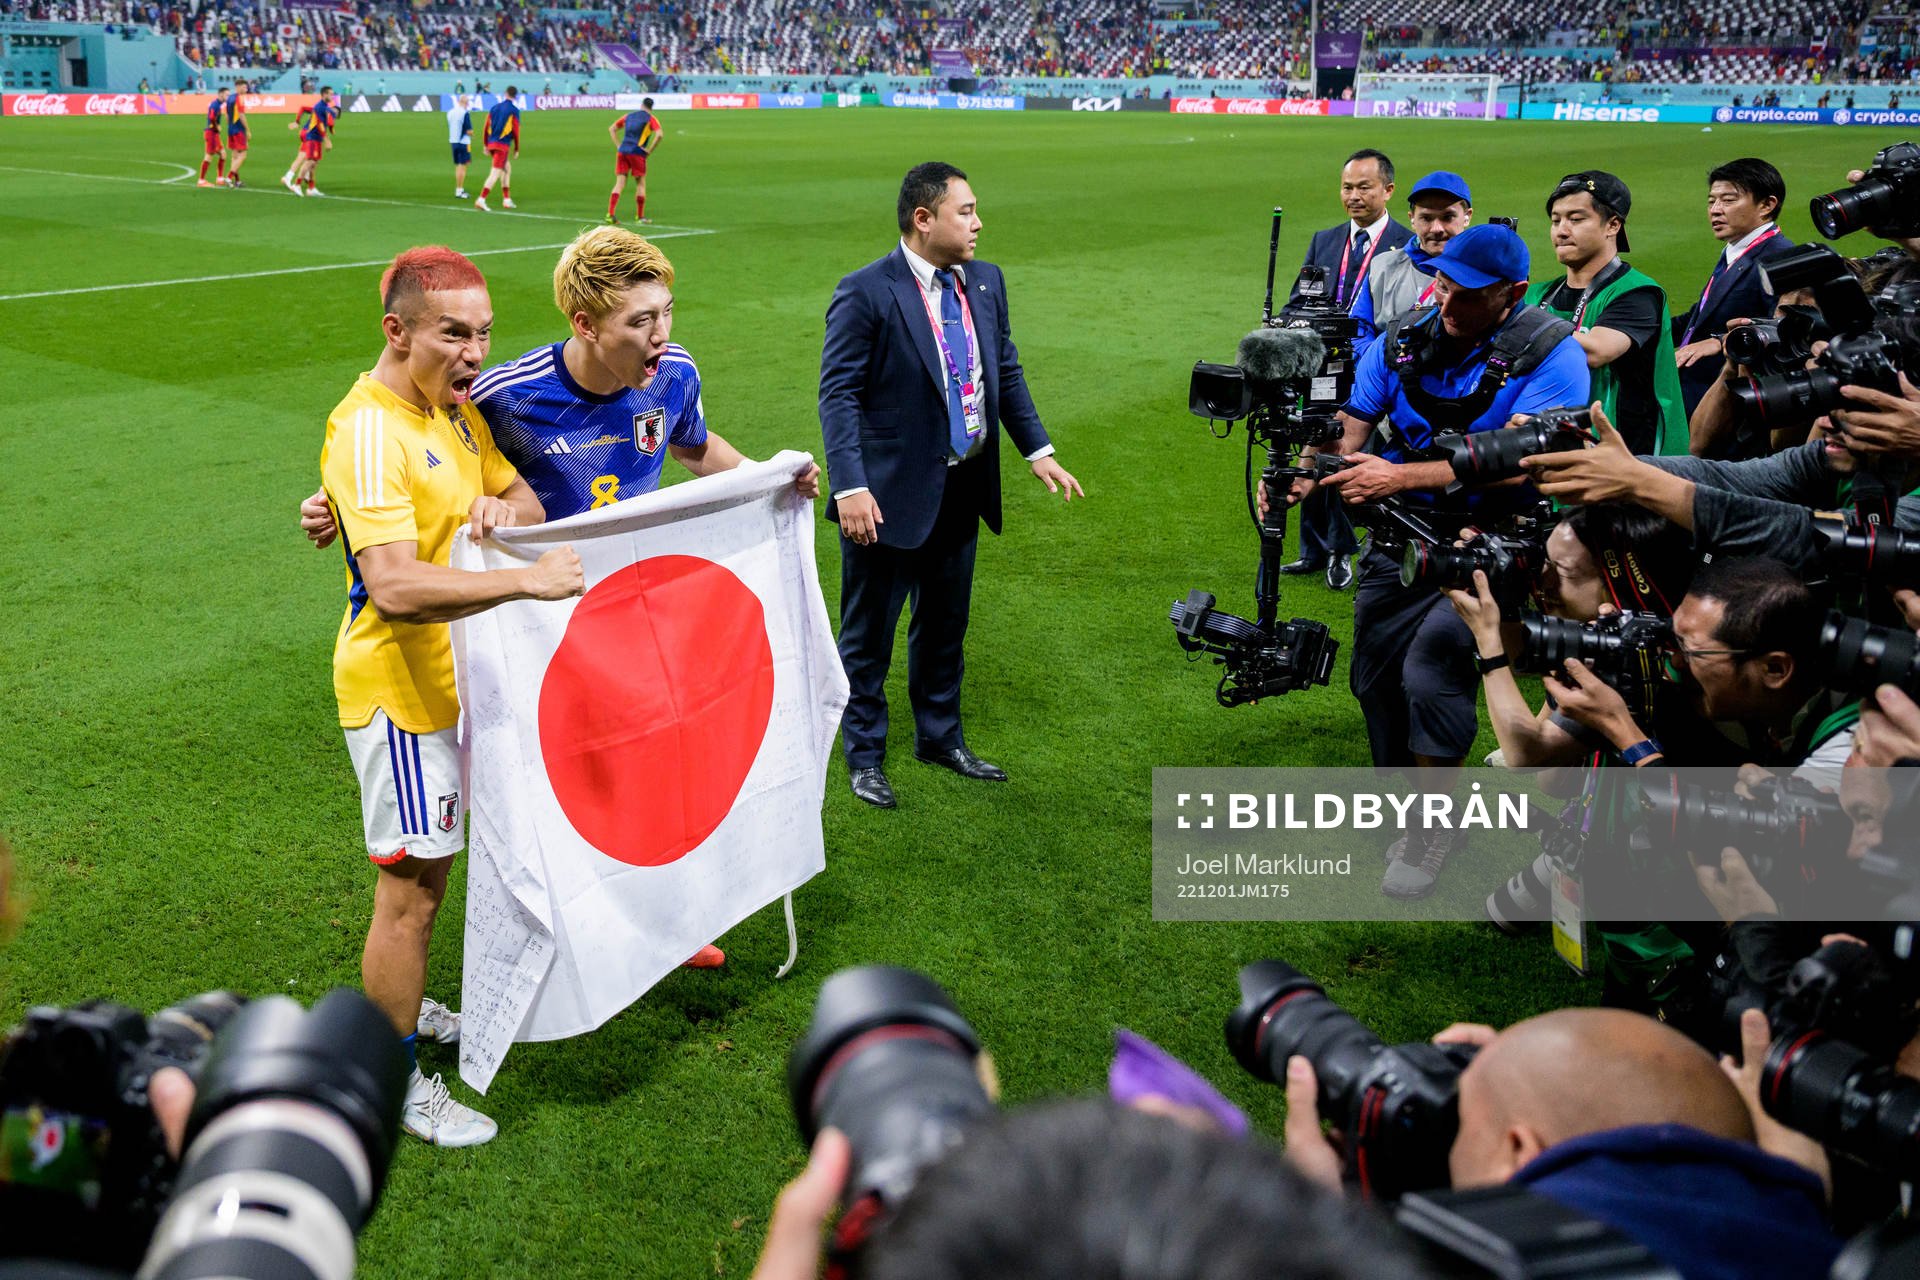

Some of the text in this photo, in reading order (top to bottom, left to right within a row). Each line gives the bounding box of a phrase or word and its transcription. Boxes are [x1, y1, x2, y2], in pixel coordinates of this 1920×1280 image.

[13, 94, 69, 115] Coca-Cola
[85, 94, 138, 115] Coca-Cola
[536, 96, 571, 110] QATAR
[574, 95, 615, 108] AIRWAYS
[1176, 98, 1216, 113] Coca-Cola
[1227, 99, 1268, 114] Coca-Cola
[1279, 99, 1322, 115] Coca-Cola
[1553, 102, 1660, 122] Hisense
[1735, 107, 1819, 121] crypto.com
[1854, 110, 1920, 124] crypto.c
[1572, 293, 1588, 323] SONY
[590, 474, 620, 510] 8
[1603, 549, 1621, 578] EOS
[1626, 552, 1650, 594] Canon
